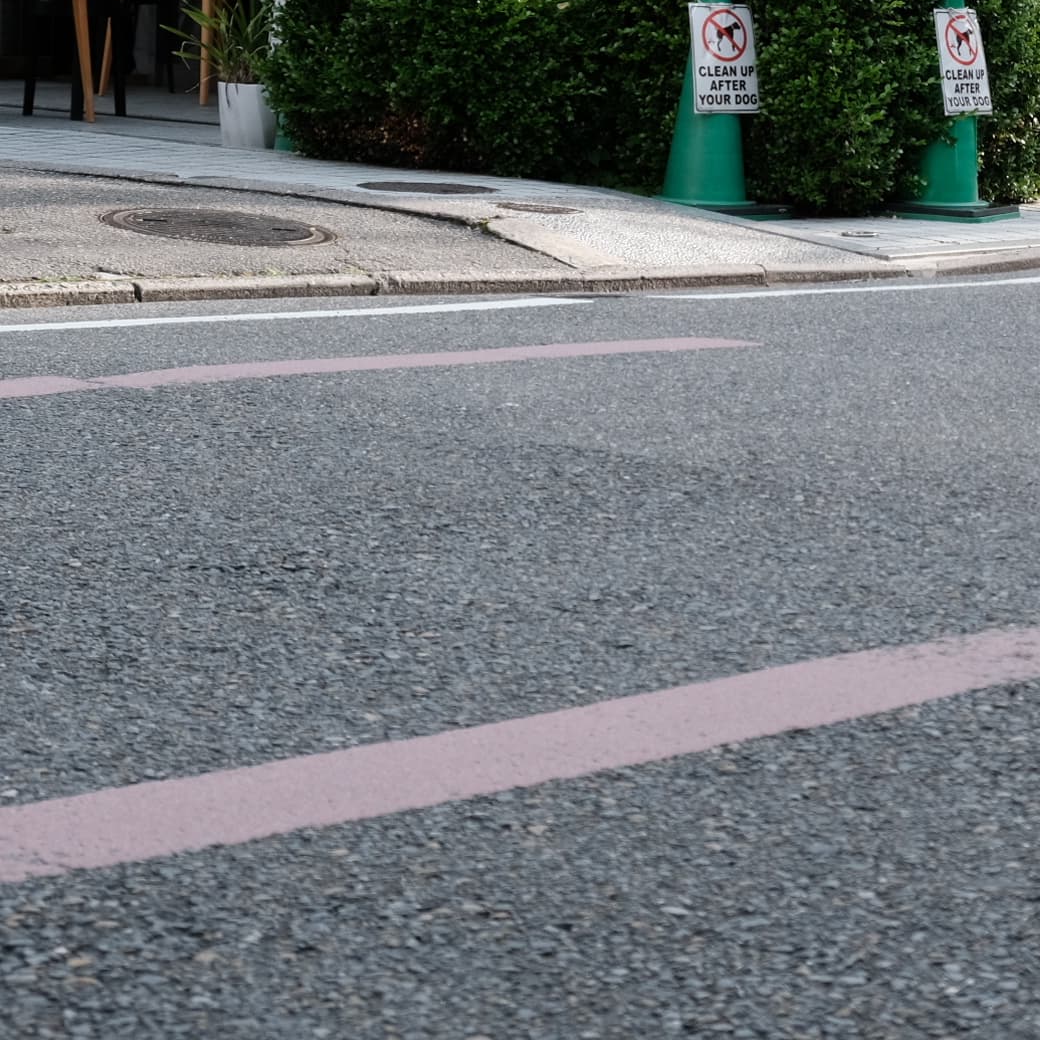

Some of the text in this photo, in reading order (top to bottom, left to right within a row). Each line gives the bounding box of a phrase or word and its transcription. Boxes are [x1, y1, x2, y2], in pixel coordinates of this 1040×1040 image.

[698, 65, 755, 77] CLEAN UP
[945, 68, 985, 81] CLEAN UP
[710, 79, 747, 91] AFTER
[954, 83, 981, 94] AFTER
[698, 93, 758, 105] YOUR DOG
[947, 96, 990, 107] YOUR DOG
